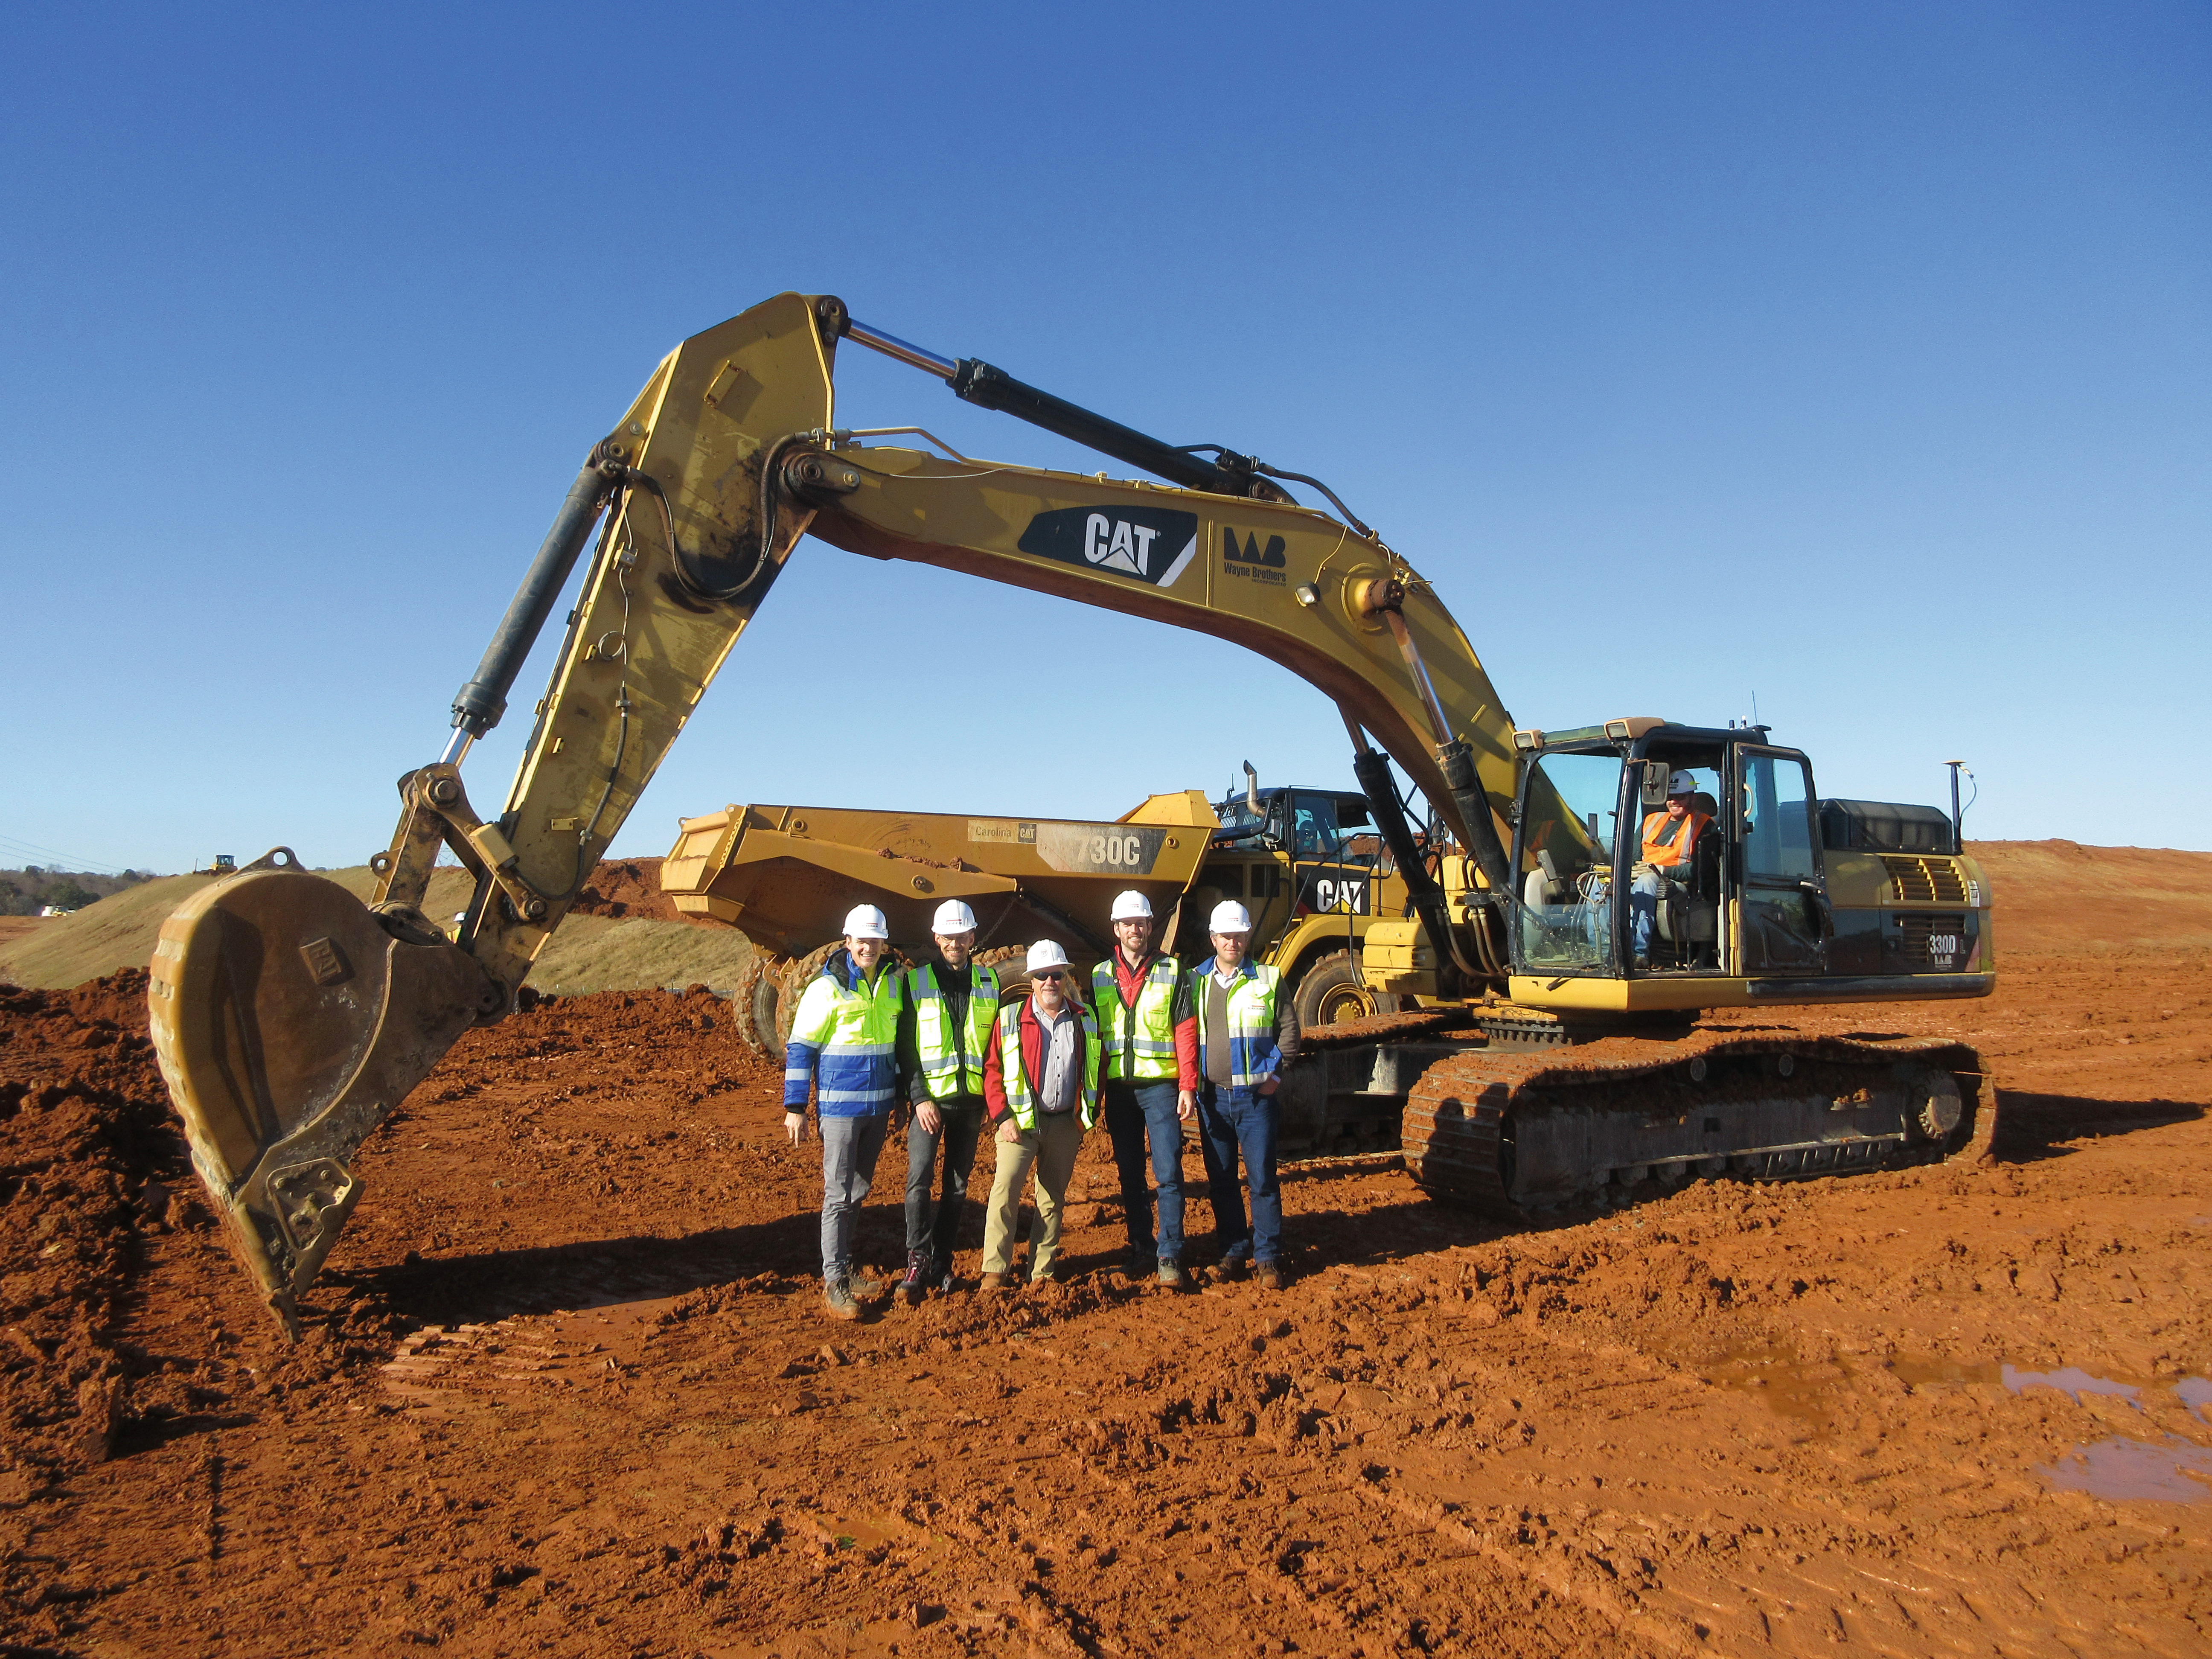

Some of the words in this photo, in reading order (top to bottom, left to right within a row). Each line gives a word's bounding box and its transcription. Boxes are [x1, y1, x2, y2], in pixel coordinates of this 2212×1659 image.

[1084, 513, 1156, 576] CAT
[1224, 562, 1250, 577] Wayne
[1252, 566, 1286, 582] Brothers
[1252, 578, 1286, 587] INCORPORATED
[976, 826, 1011, 837] Carolina
[1020, 828, 1035, 838] CAT
[1074, 835, 1140, 865] 730C
[1317, 879, 1365, 914] CAT
[1930, 934, 1956, 954] 330D
